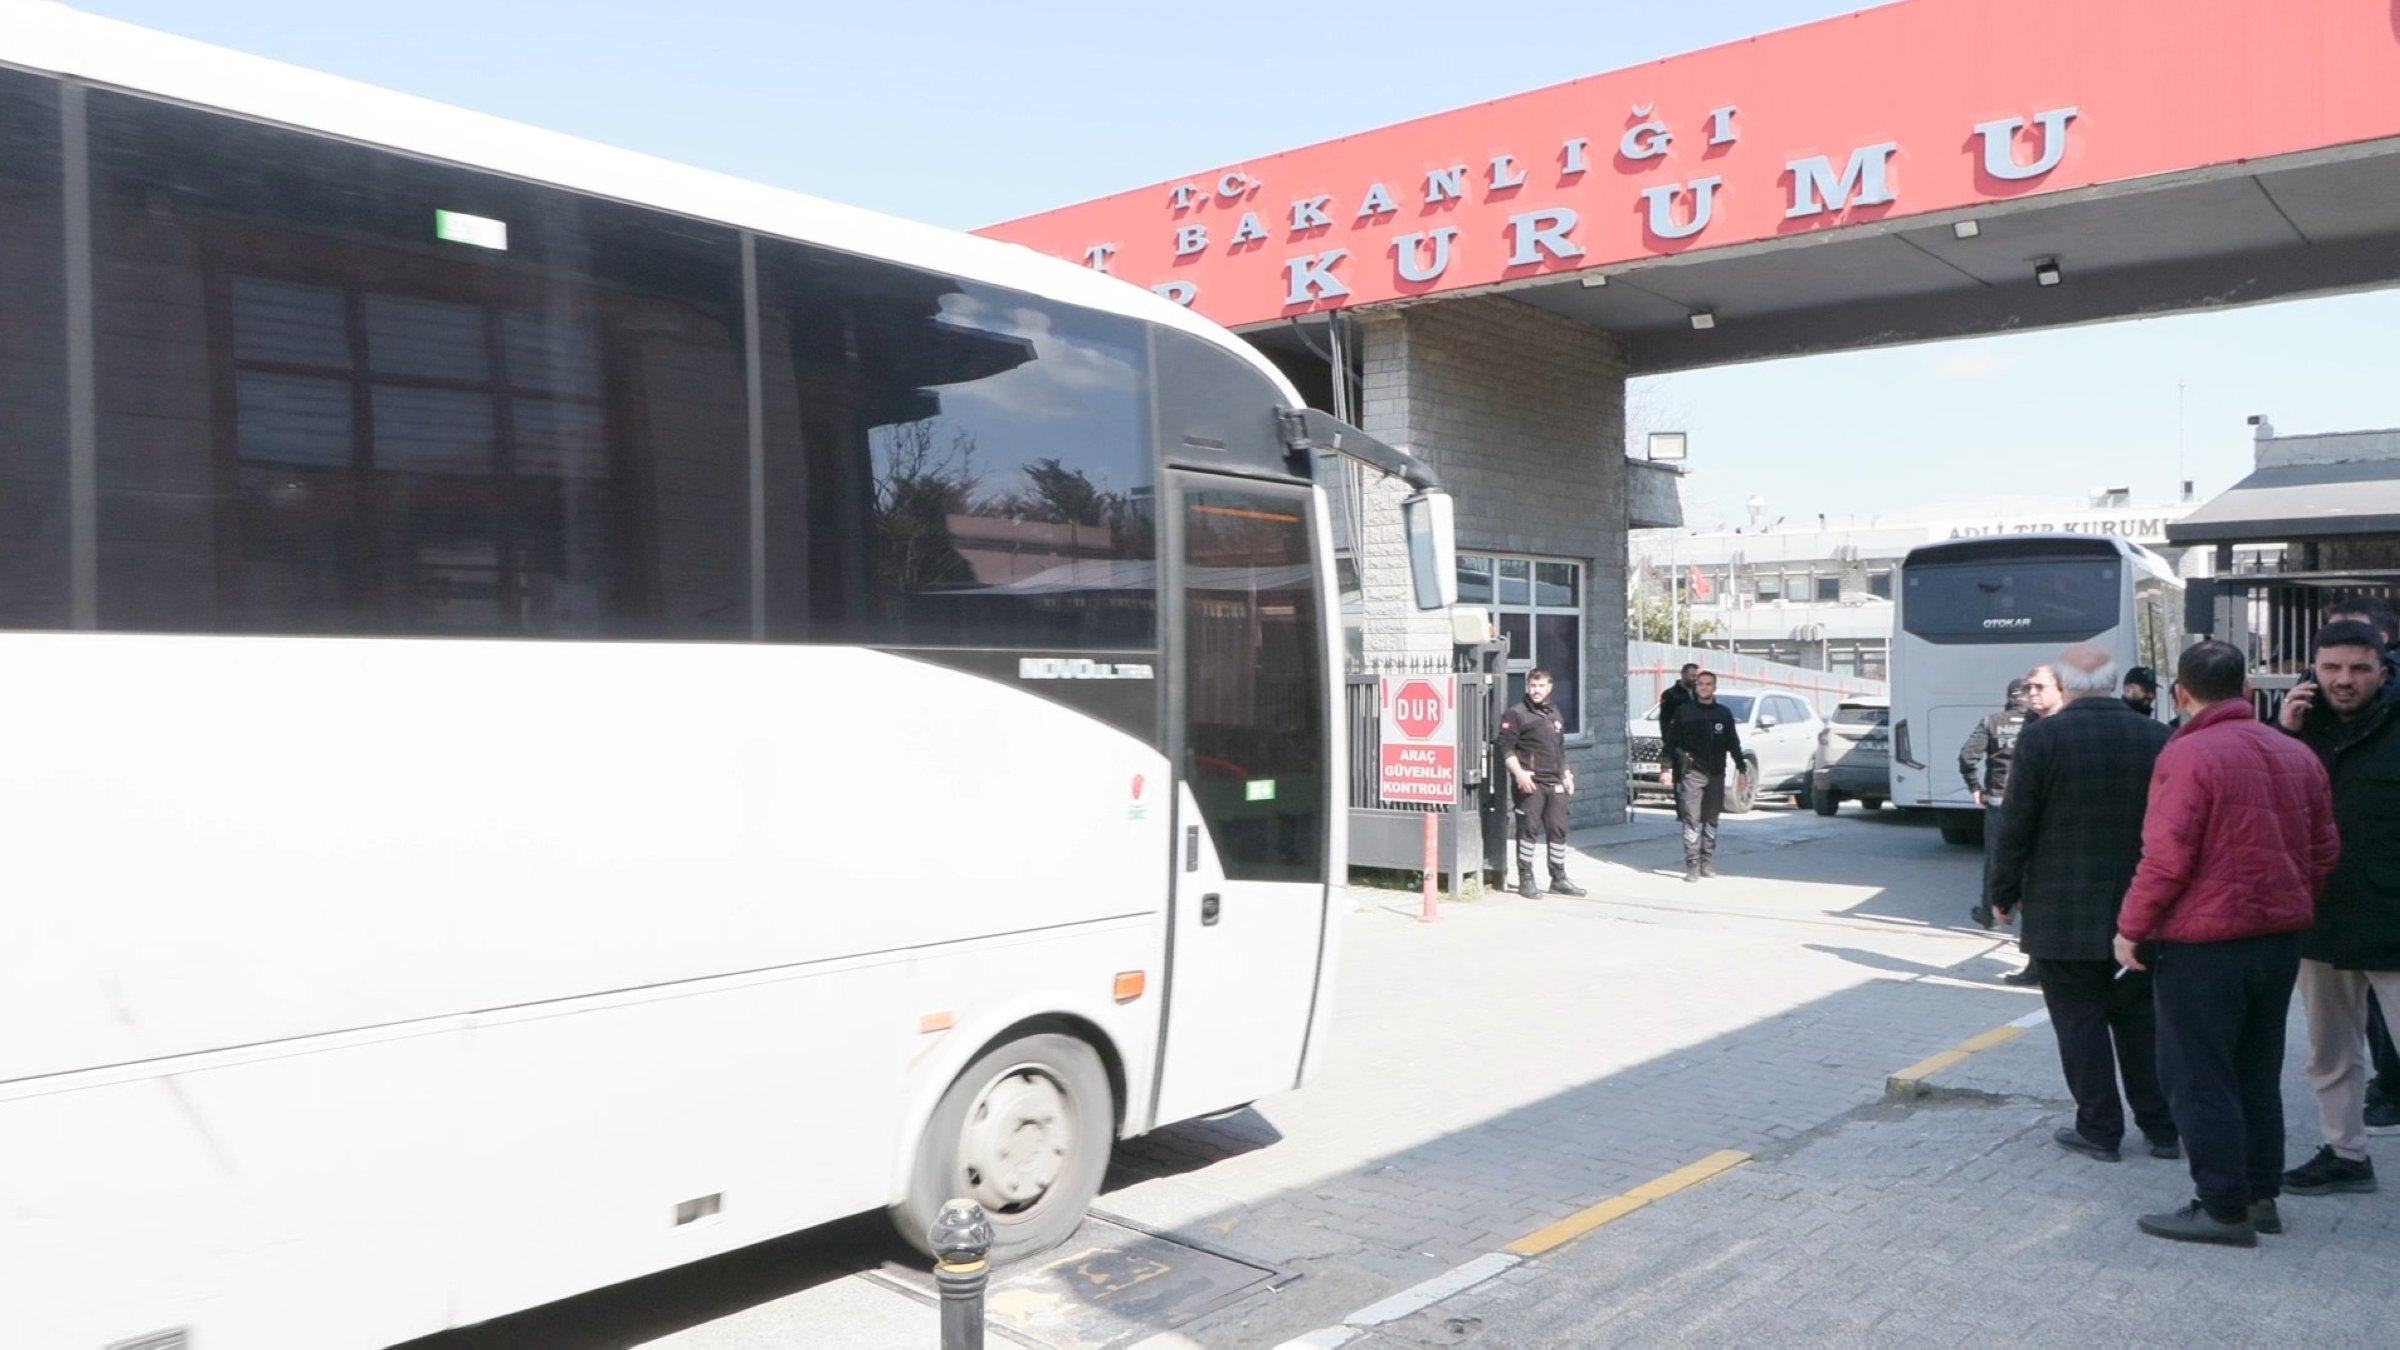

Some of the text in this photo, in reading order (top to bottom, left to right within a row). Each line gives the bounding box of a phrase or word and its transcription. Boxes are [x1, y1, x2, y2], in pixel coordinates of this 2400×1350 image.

[1175, 102, 1738, 256] BAKANLIĞI
[1169, 173, 1261, 209] T.C.
[1285, 106, 2078, 305] KURUMU
[2064, 518, 2169, 537] KURUM
[1983, 618, 2031, 628] OTOKAR
[1397, 698, 1439, 721] DUR
[1400, 750, 1436, 765] ARAÇ
[1384, 763, 1452, 779] GÜVENLİK
[1383, 781, 1453, 796] KONTROLÜ
